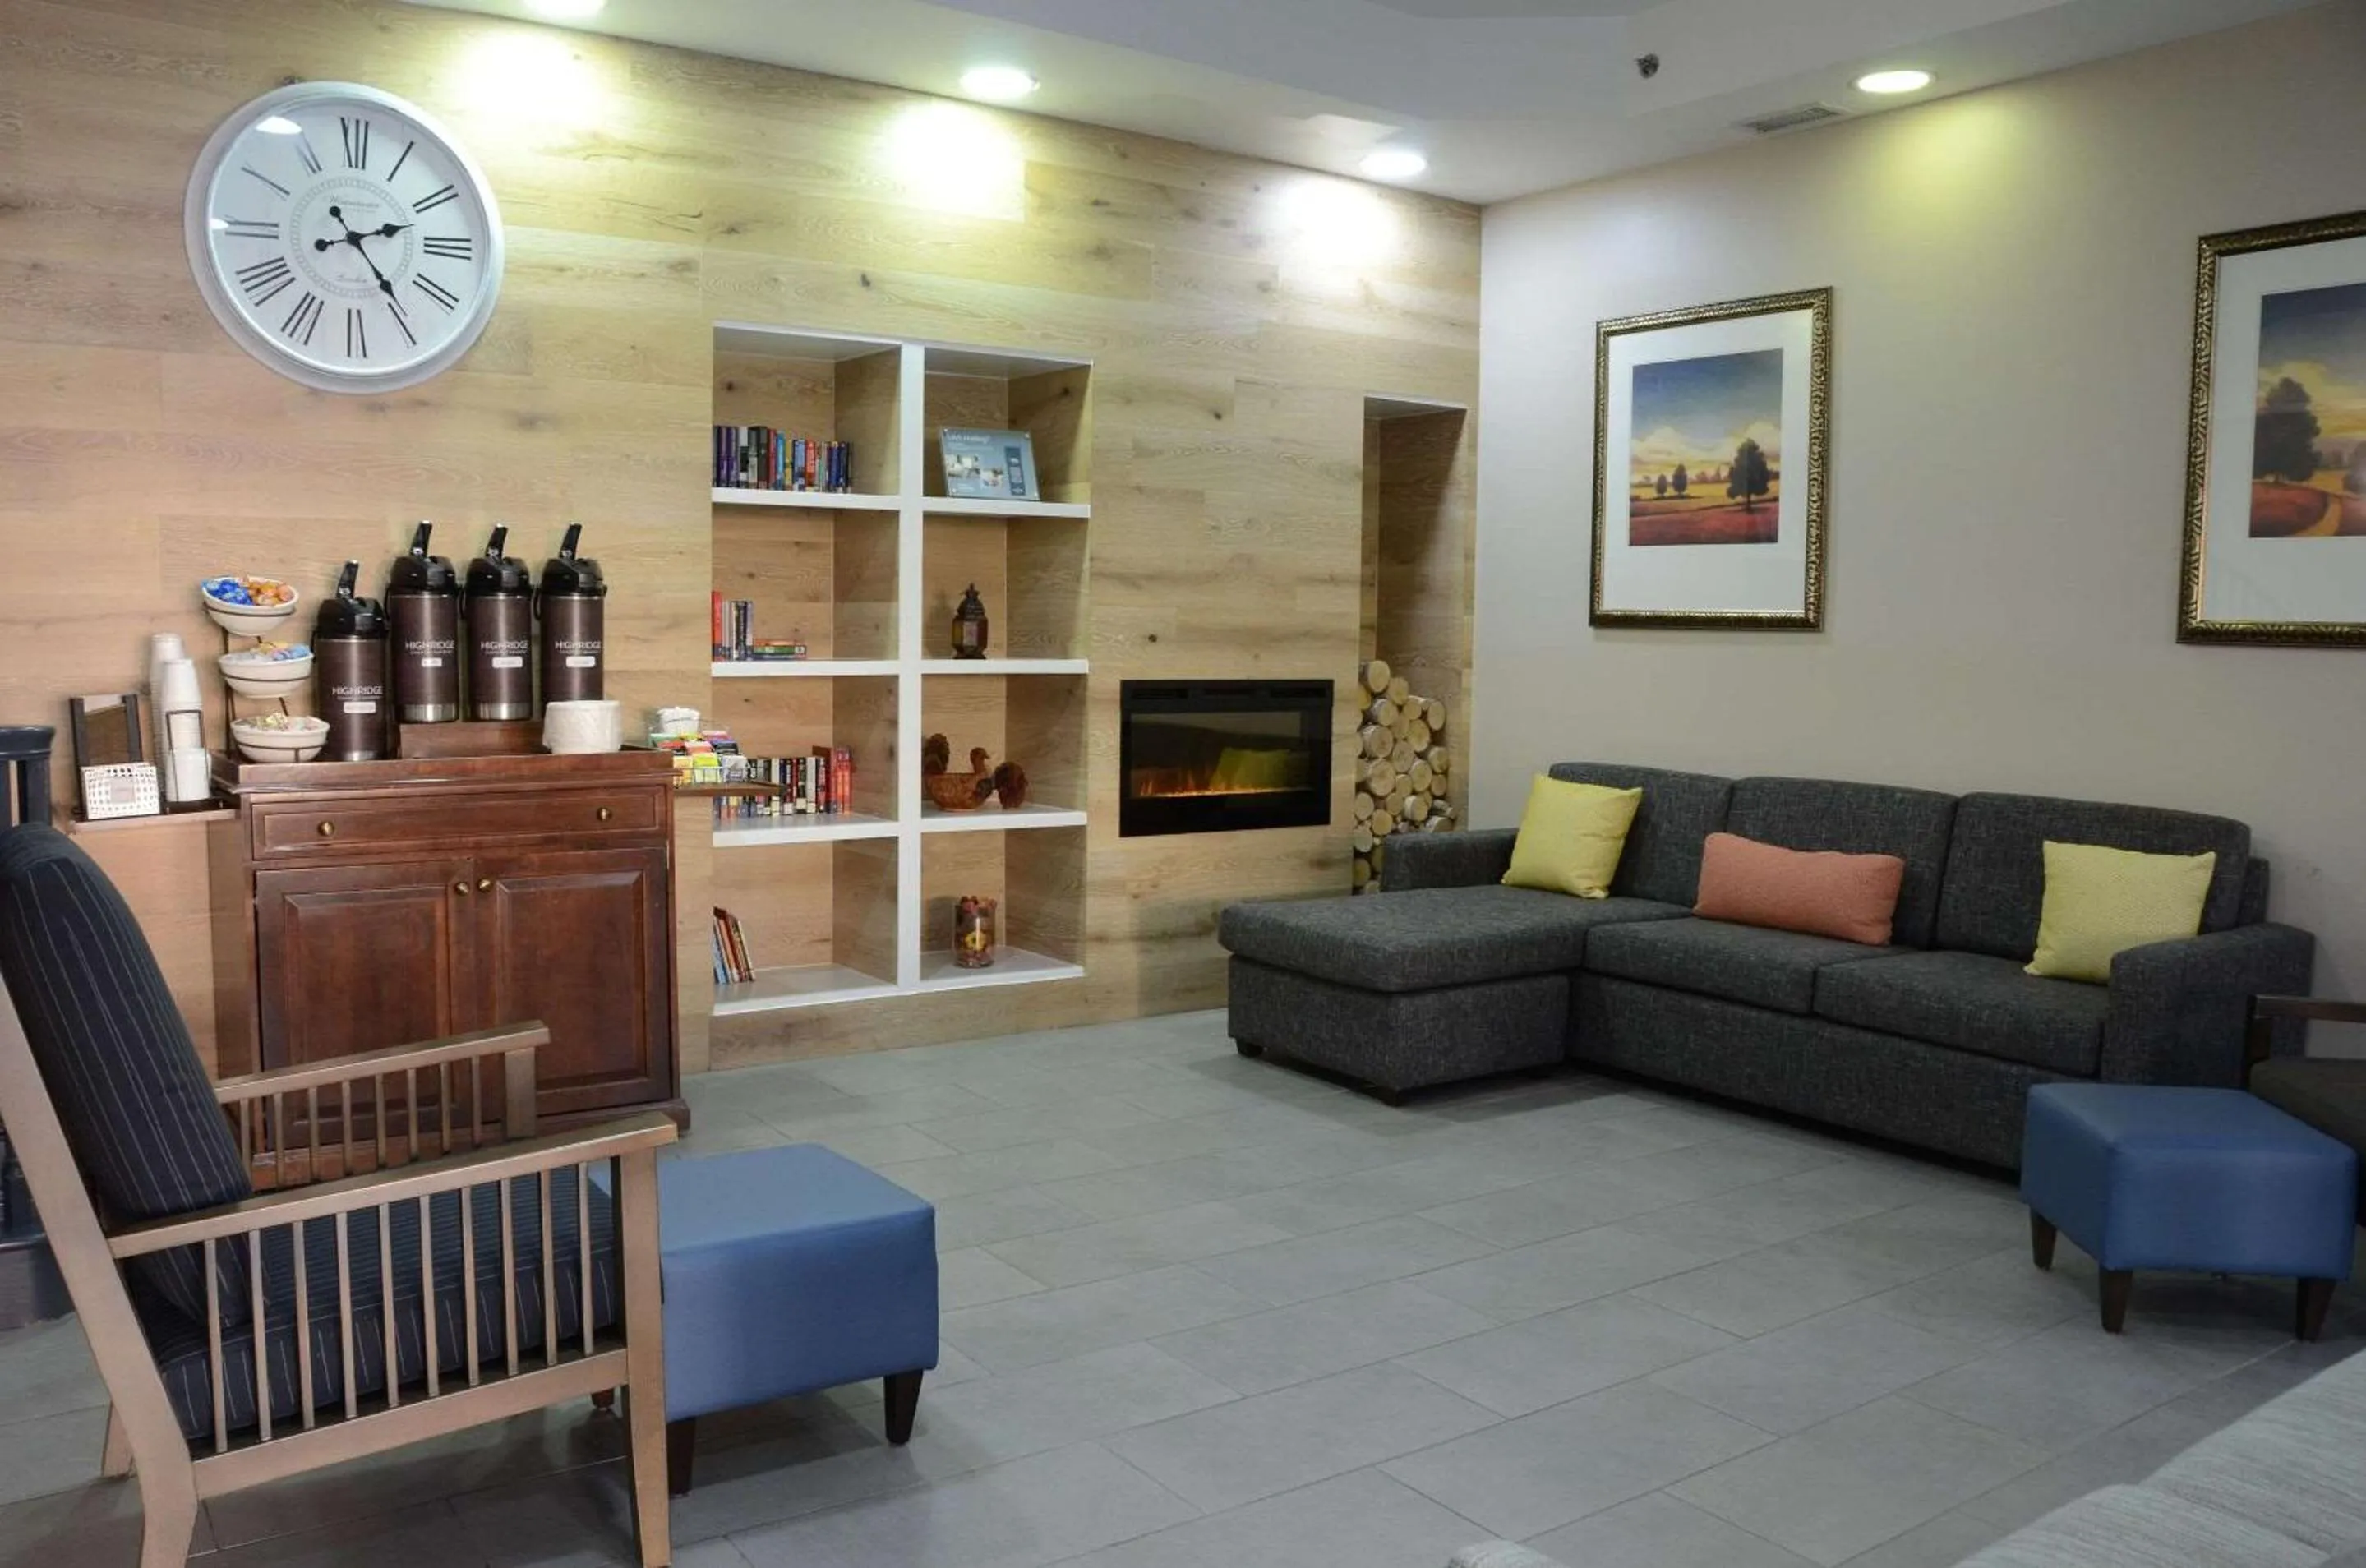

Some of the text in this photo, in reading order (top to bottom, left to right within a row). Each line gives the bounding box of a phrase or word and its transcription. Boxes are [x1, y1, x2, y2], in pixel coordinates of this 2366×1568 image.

[339, 116, 369, 170] XII
[387, 141, 414, 182] I
[413, 184, 459, 214] II
[423, 236, 473, 261] III
